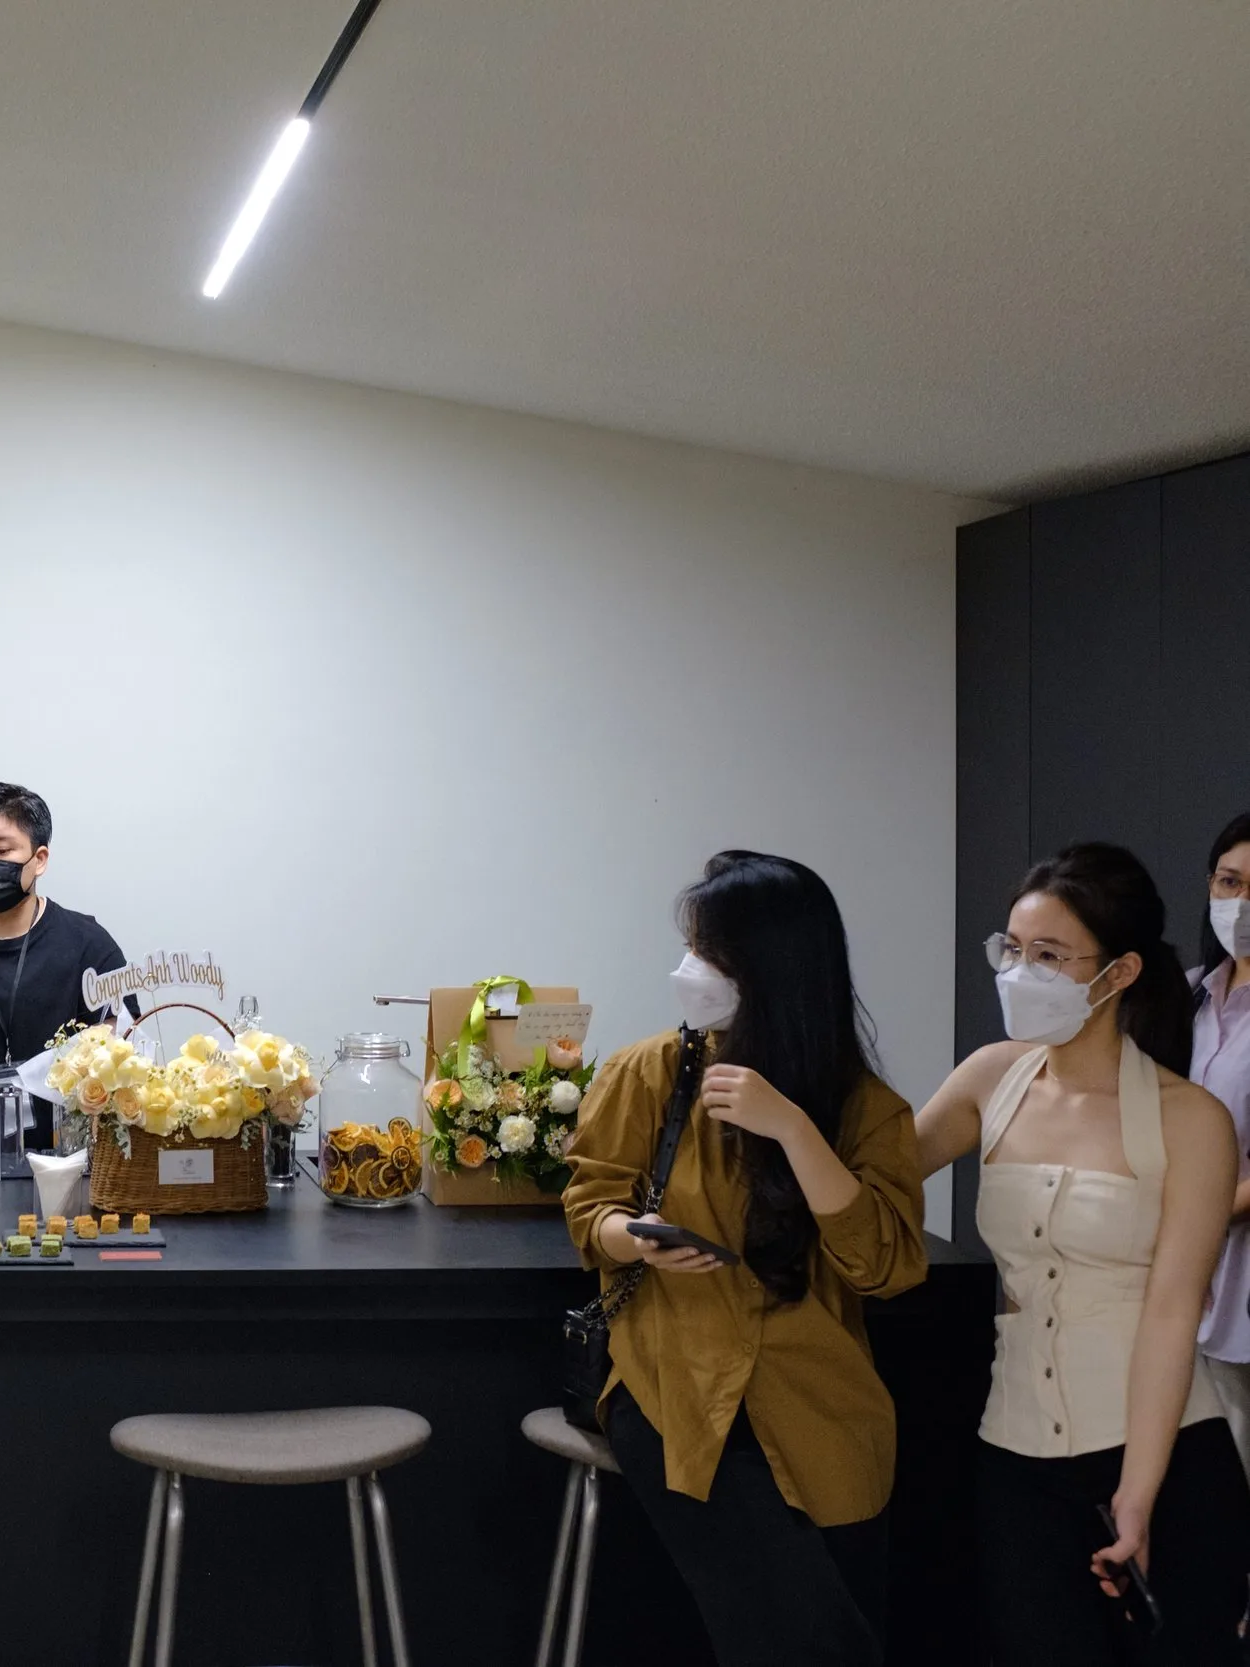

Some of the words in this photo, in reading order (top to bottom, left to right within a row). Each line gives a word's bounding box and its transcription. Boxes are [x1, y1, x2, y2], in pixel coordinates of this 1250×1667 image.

[86, 963, 144, 1011] Congrats
[147, 952, 174, 986] Anh
[172, 952, 225, 1002] Woody
